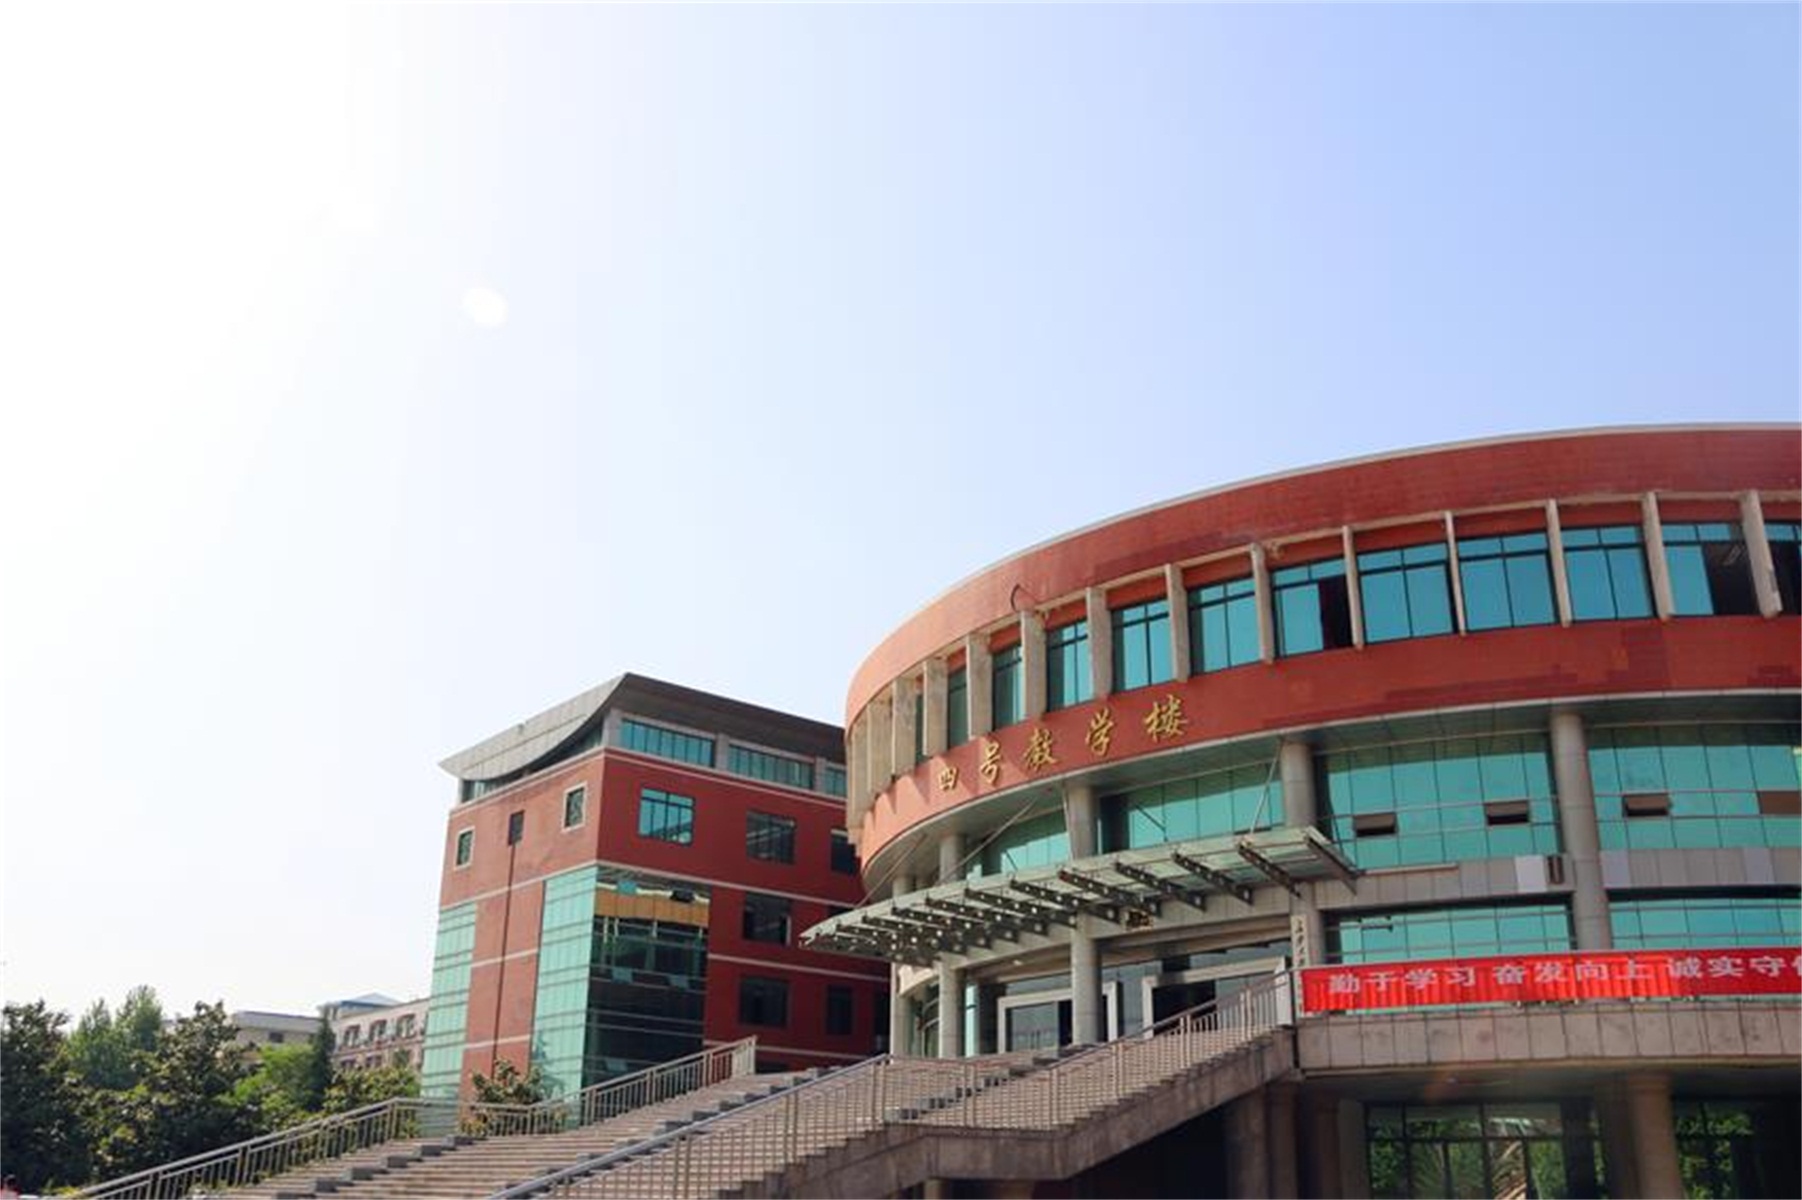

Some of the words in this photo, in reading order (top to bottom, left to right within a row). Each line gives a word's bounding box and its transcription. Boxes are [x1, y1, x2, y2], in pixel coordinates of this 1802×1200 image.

[938, 694, 1188, 791] 四号教学楼
[1329, 967, 1476, 993] 勤于学习
[1492, 959, 1655, 984] 奋发向上
